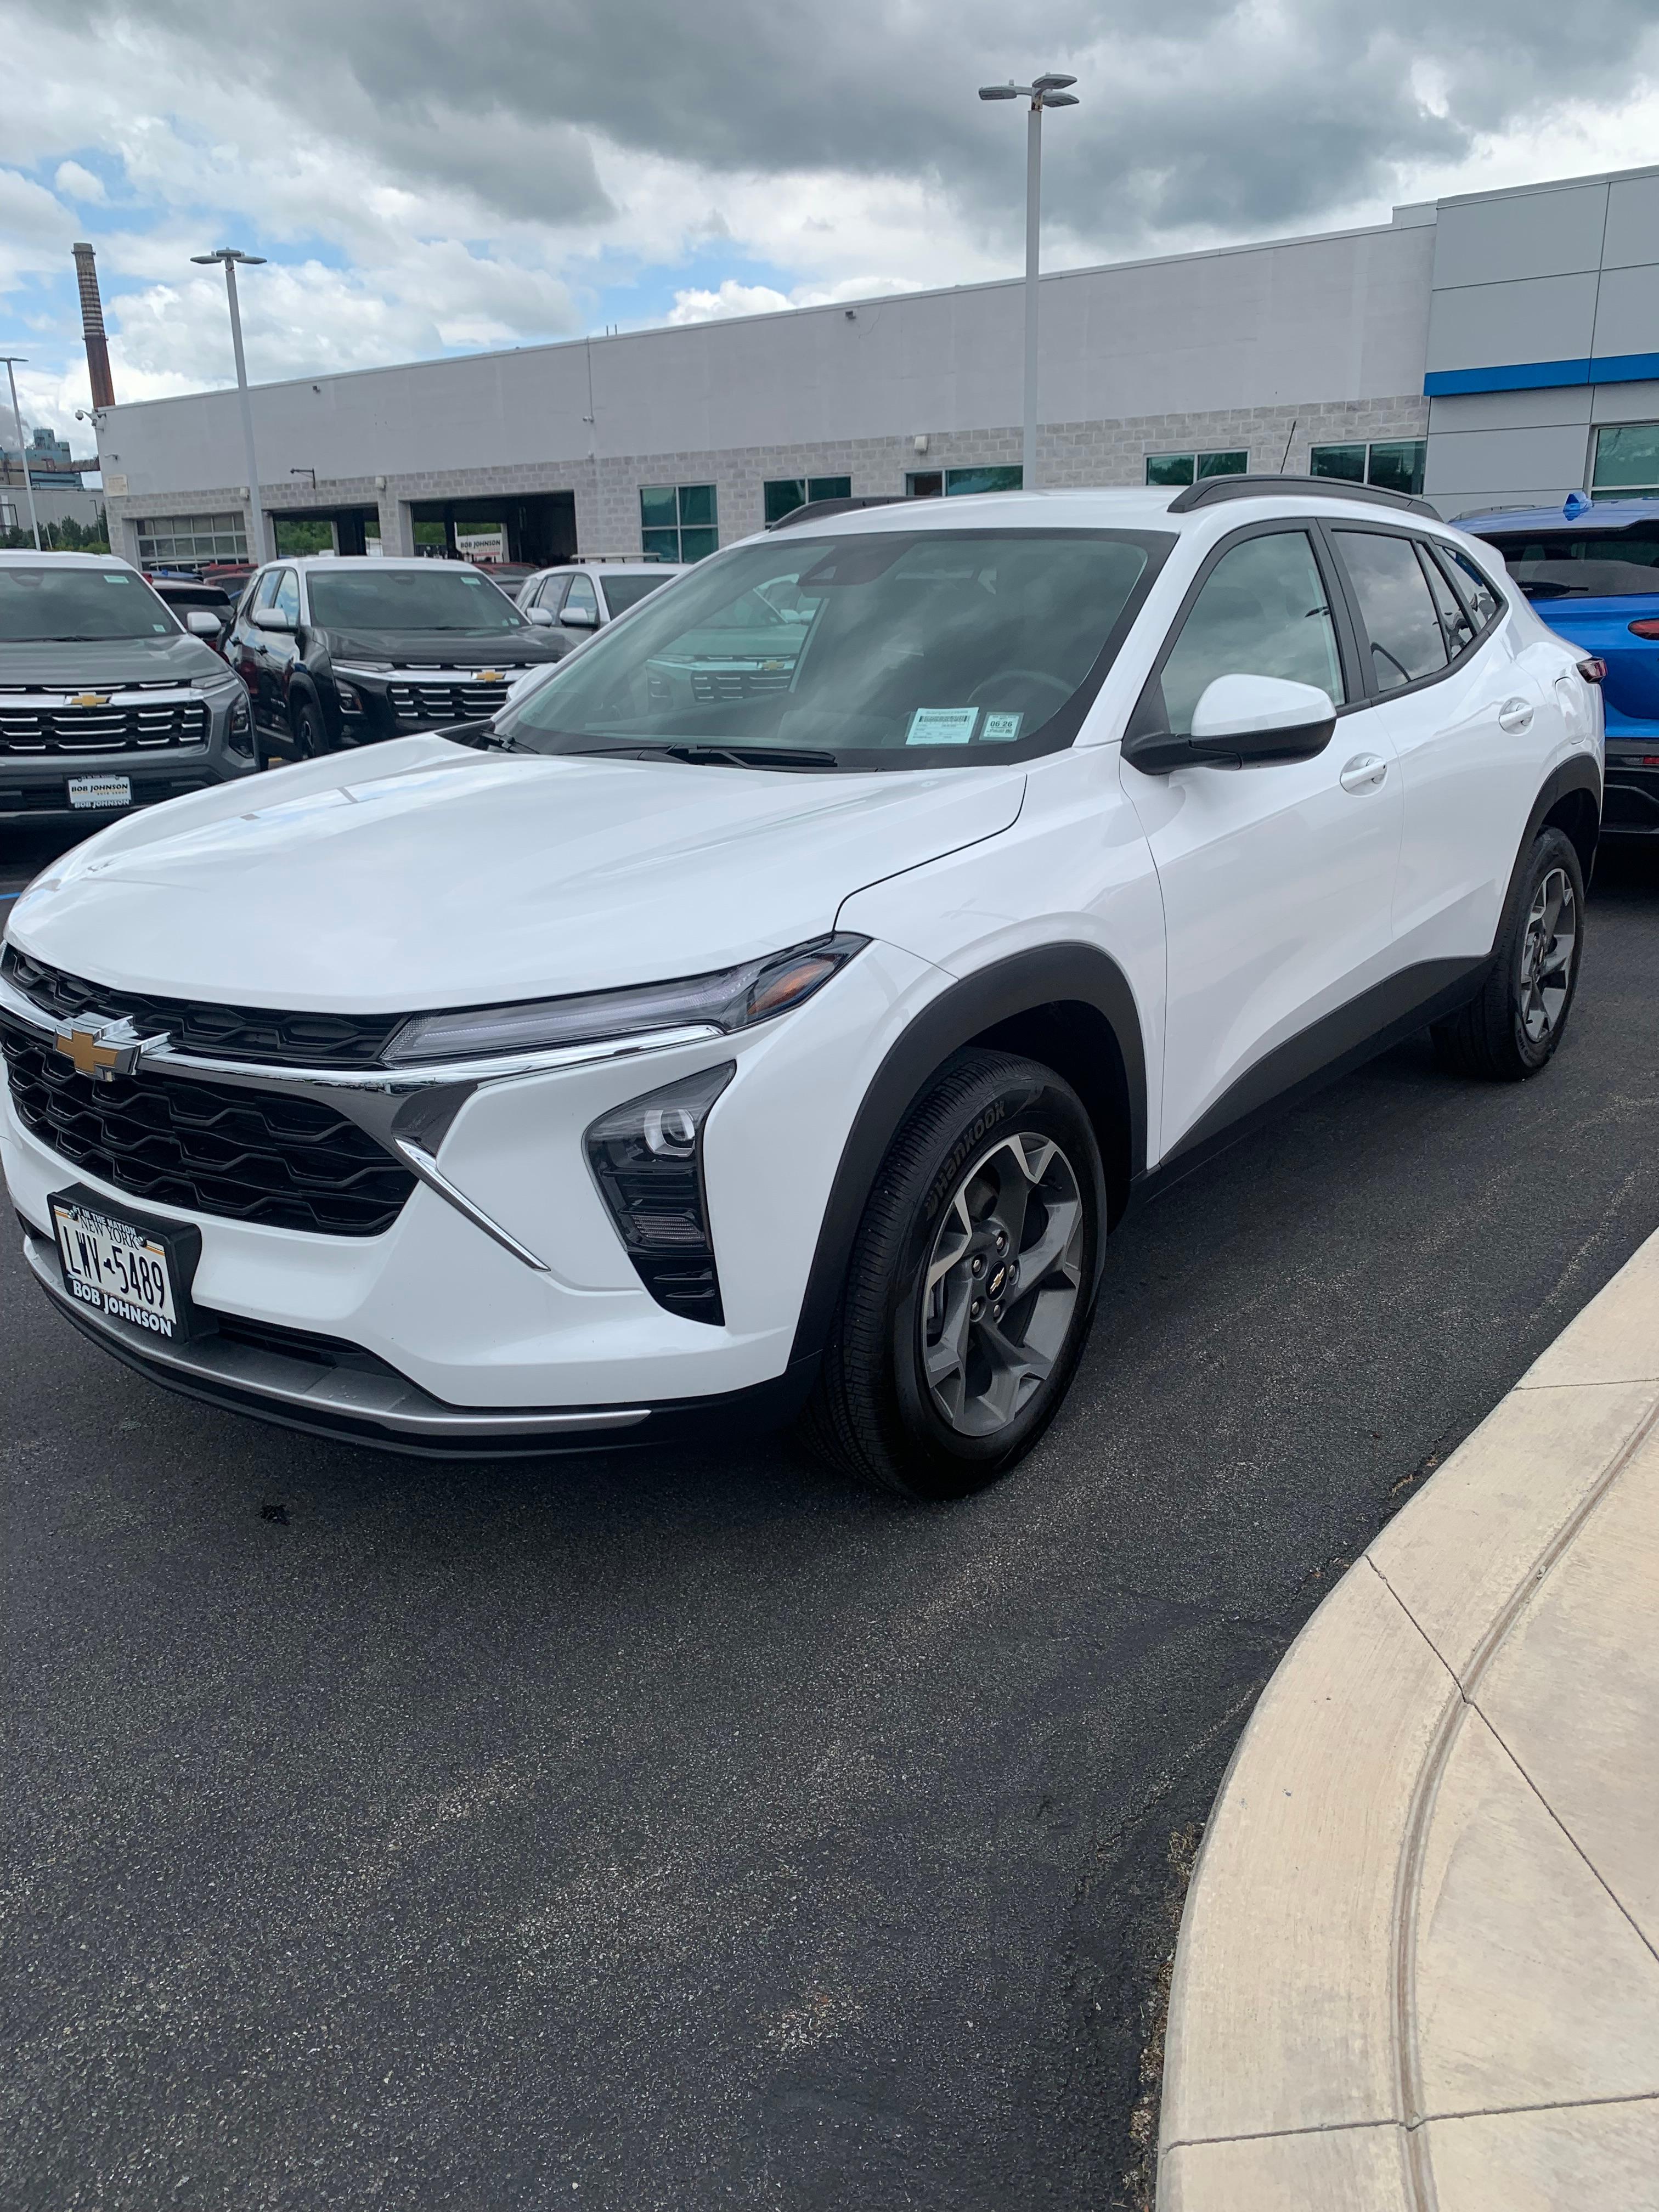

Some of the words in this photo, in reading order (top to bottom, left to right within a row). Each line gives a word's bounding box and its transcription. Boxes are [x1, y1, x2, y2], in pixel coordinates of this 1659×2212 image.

[473, 539, 500, 549] JOHNSON
[91, 783, 128, 793] JOHNSON
[92, 799, 129, 809] JOHNSON
[82, 1209, 91, 1219] IN
[91, 1212, 107, 1225] THE
[107, 1218, 136, 1235] NATION
[78, 1215, 104, 1237] NEW
[105, 1226, 139, 1250] YORK
[73, 1280, 101, 1306] BOB
[104, 1295, 173, 1338] JOHNSON
